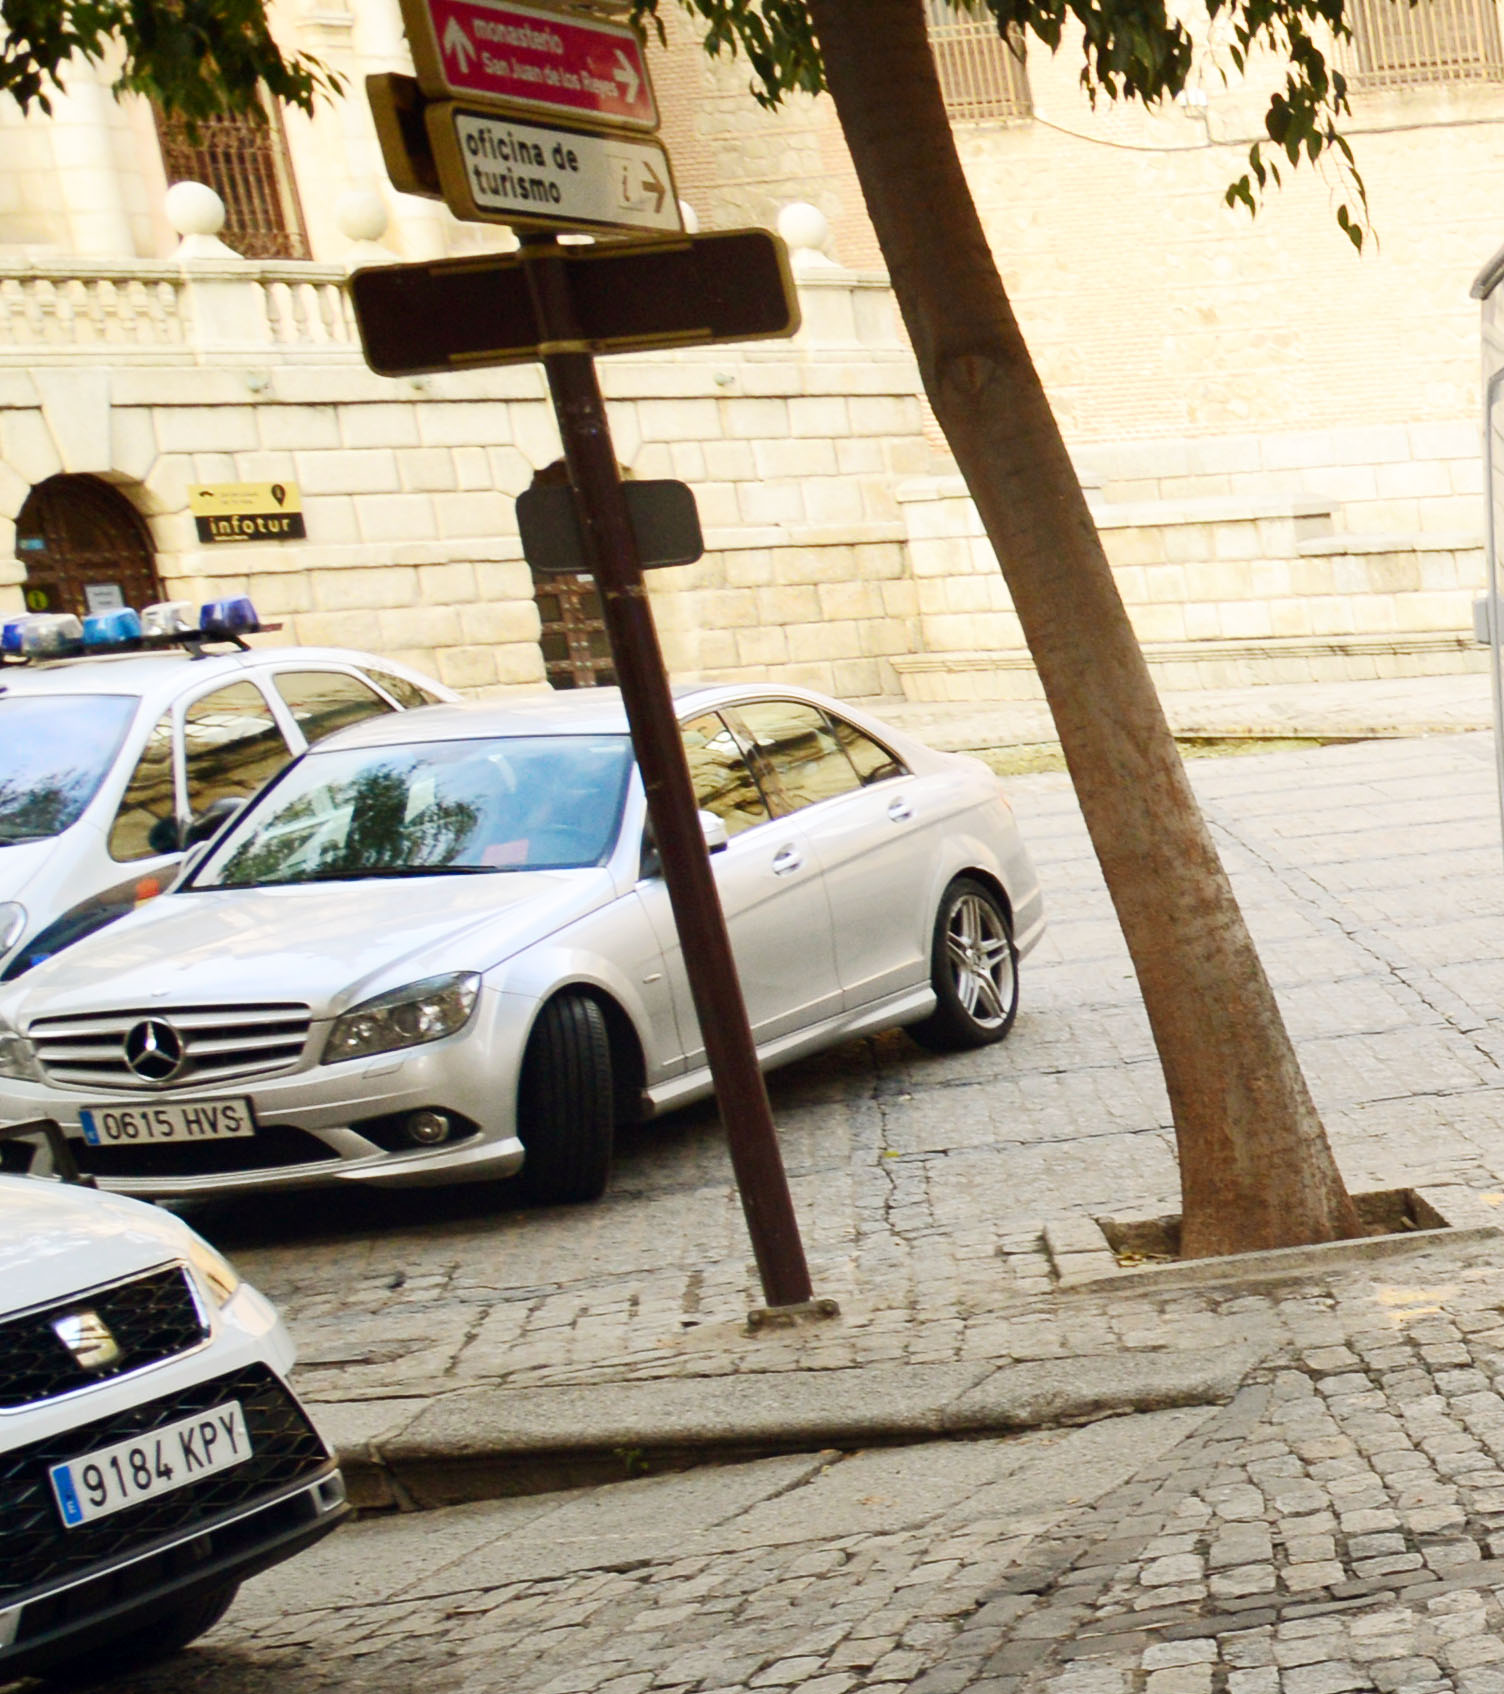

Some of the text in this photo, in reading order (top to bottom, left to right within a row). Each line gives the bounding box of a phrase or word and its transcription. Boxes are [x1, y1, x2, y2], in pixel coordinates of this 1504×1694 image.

[472, 18, 565, 55] monasterio
[481, 50, 511, 77] San
[511, 56, 543, 83] Juan
[543, 64, 561, 87] de
[465, 127, 579, 172] oficina de
[473, 164, 562, 204] turismo
[208, 515, 291, 534] infotur
[103, 1105, 243, 1140] 0615 HVS
[82, 1439, 174, 1507] 9184
[179, 1411, 239, 1473] KPY
